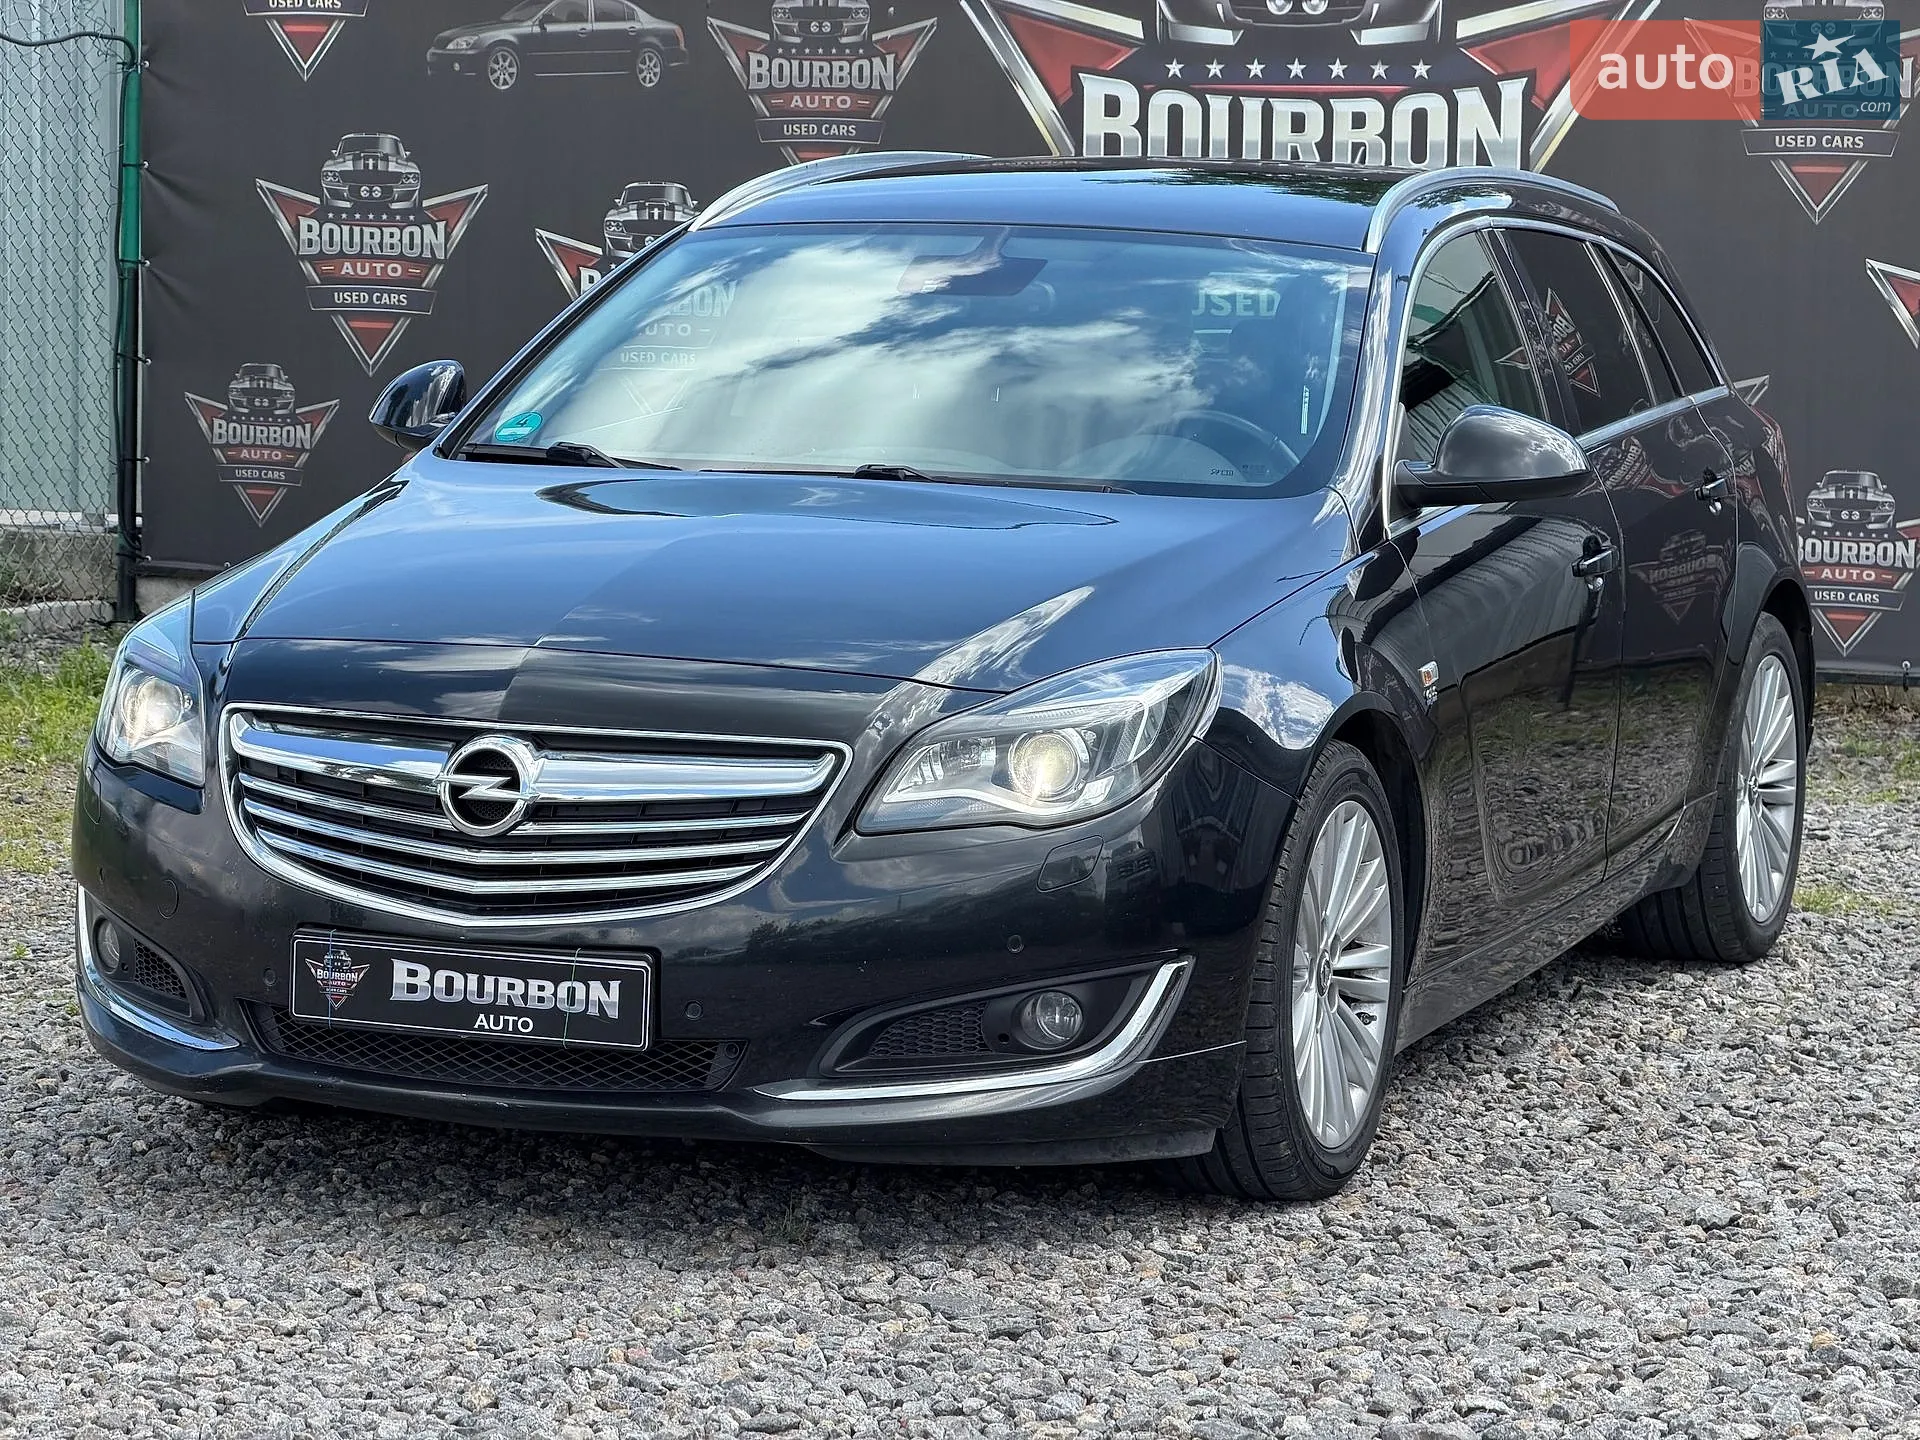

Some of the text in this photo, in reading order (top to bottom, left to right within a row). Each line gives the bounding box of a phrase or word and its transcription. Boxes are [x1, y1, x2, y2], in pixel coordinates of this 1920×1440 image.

[748, 50, 896, 91] BOURBON
[790, 95, 851, 109] AUTO
[783, 124, 857, 136] USED CARS
[1775, 135, 1864, 149] USED CARS
[298, 216, 446, 259] BOURBON
[340, 262, 402, 277] AUTO
[334, 292, 408, 306] USED CARS
[639, 323, 692, 337] UTO
[621, 351, 696, 365] USED CARS
[212, 417, 312, 450] BOURBON
[240, 449, 282, 460] AUTO
[235, 469, 286, 480] USED CARS
[1820, 568, 1876, 582] AUTO
[1814, 590, 1880, 603] USED CARS
[317, 968, 358, 982] BOURBON
[390, 958, 622, 1020] BOURBON
[474, 1014, 534, 1033] AUTO
